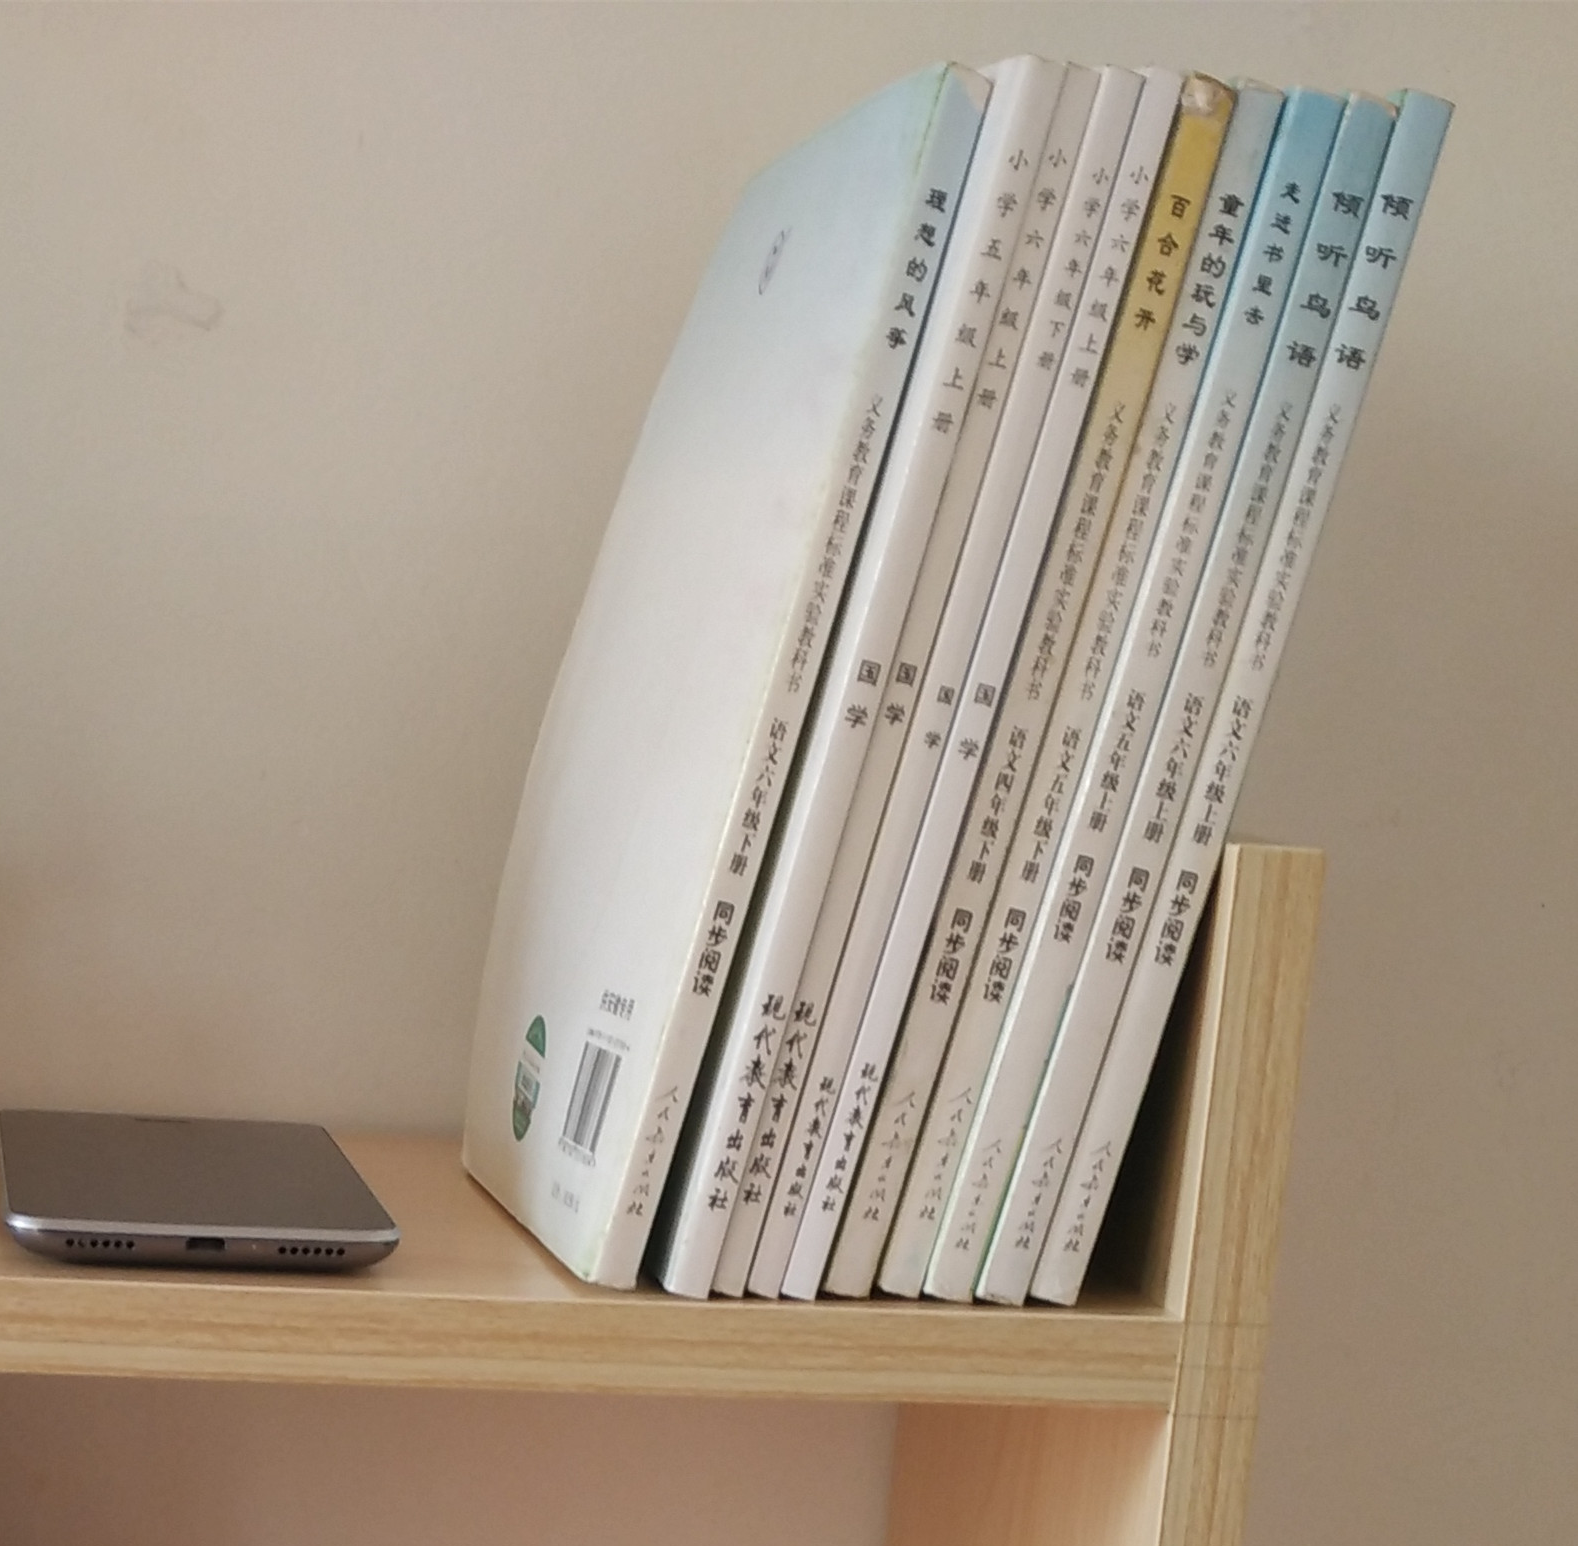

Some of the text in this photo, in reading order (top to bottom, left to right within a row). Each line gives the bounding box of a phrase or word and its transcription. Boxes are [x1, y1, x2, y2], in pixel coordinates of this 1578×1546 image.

[886, 188, 948, 350] 理想的风筝
[933, 149, 1029, 434] 小学五年级上册
[978, 148, 1067, 409] 小学六年级上册
[1038, 168, 1110, 371] 小学六年级下册
[1071, 166, 1149, 388] 小学六年级上册
[1133, 194, 1191, 330] 百合花开
[1175, 193, 1244, 366] 童年的玩与学
[1243, 181, 1301, 326] 走进书里去
[1286, 190, 1366, 370] 倾听鸟语
[1334, 192, 1414, 371] 倾听鸟语
[845, 659, 881, 728] 国学
[692, 900, 735, 998] 同步阅读
[930, 907, 973, 1006] 同步阅读
[983, 907, 1026, 1005] 同步阅读
[1053, 854, 1094, 944] 同步阅读
[1105, 866, 1150, 965] 同步阅读
[1155, 869, 1198, 967] 同步阅读
[708, 994, 785, 1212] 现代教育出版社
[743, 1001, 816, 1204] 现代教育出版社
